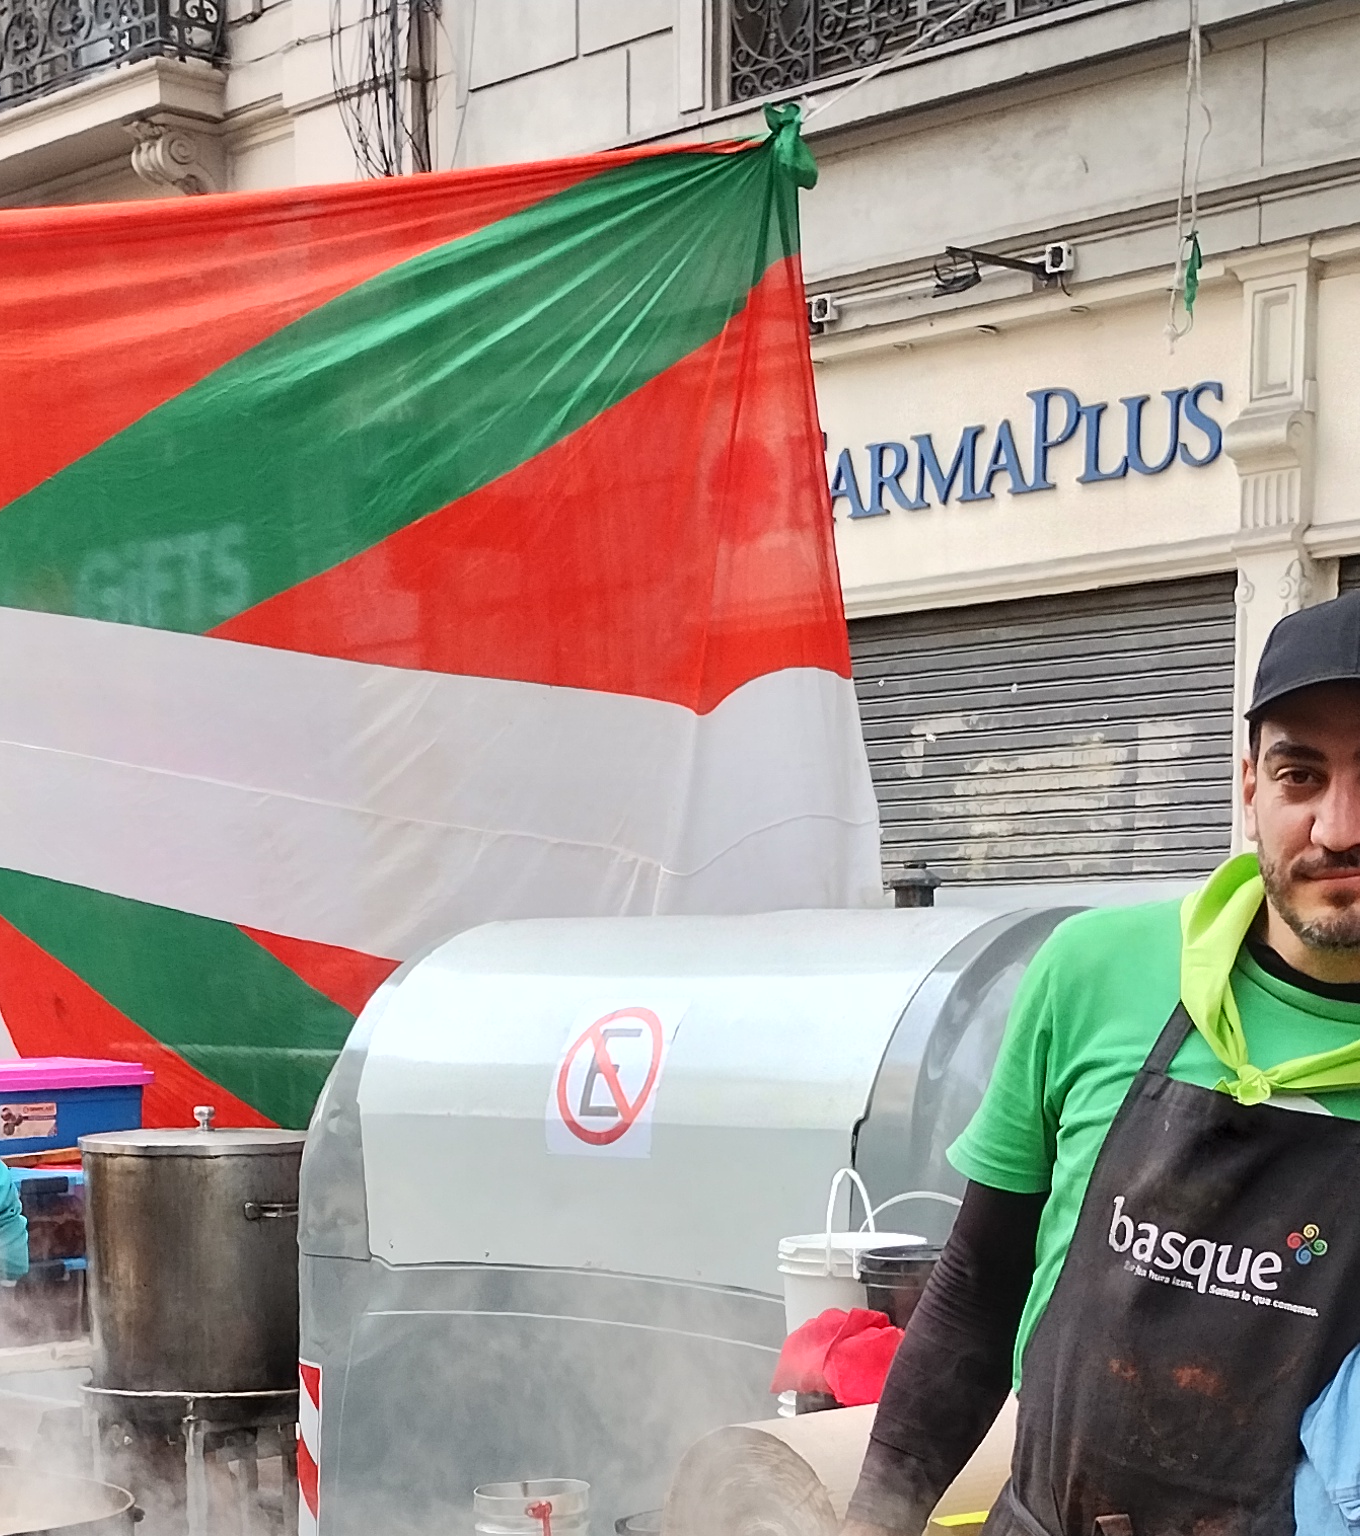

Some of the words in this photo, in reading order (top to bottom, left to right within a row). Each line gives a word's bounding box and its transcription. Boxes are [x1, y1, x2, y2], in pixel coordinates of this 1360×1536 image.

[824, 379, 1224, 523] ARMAPLUS
[579, 1028, 643, 1117] E
[1108, 1195, 1283, 1294] basque
